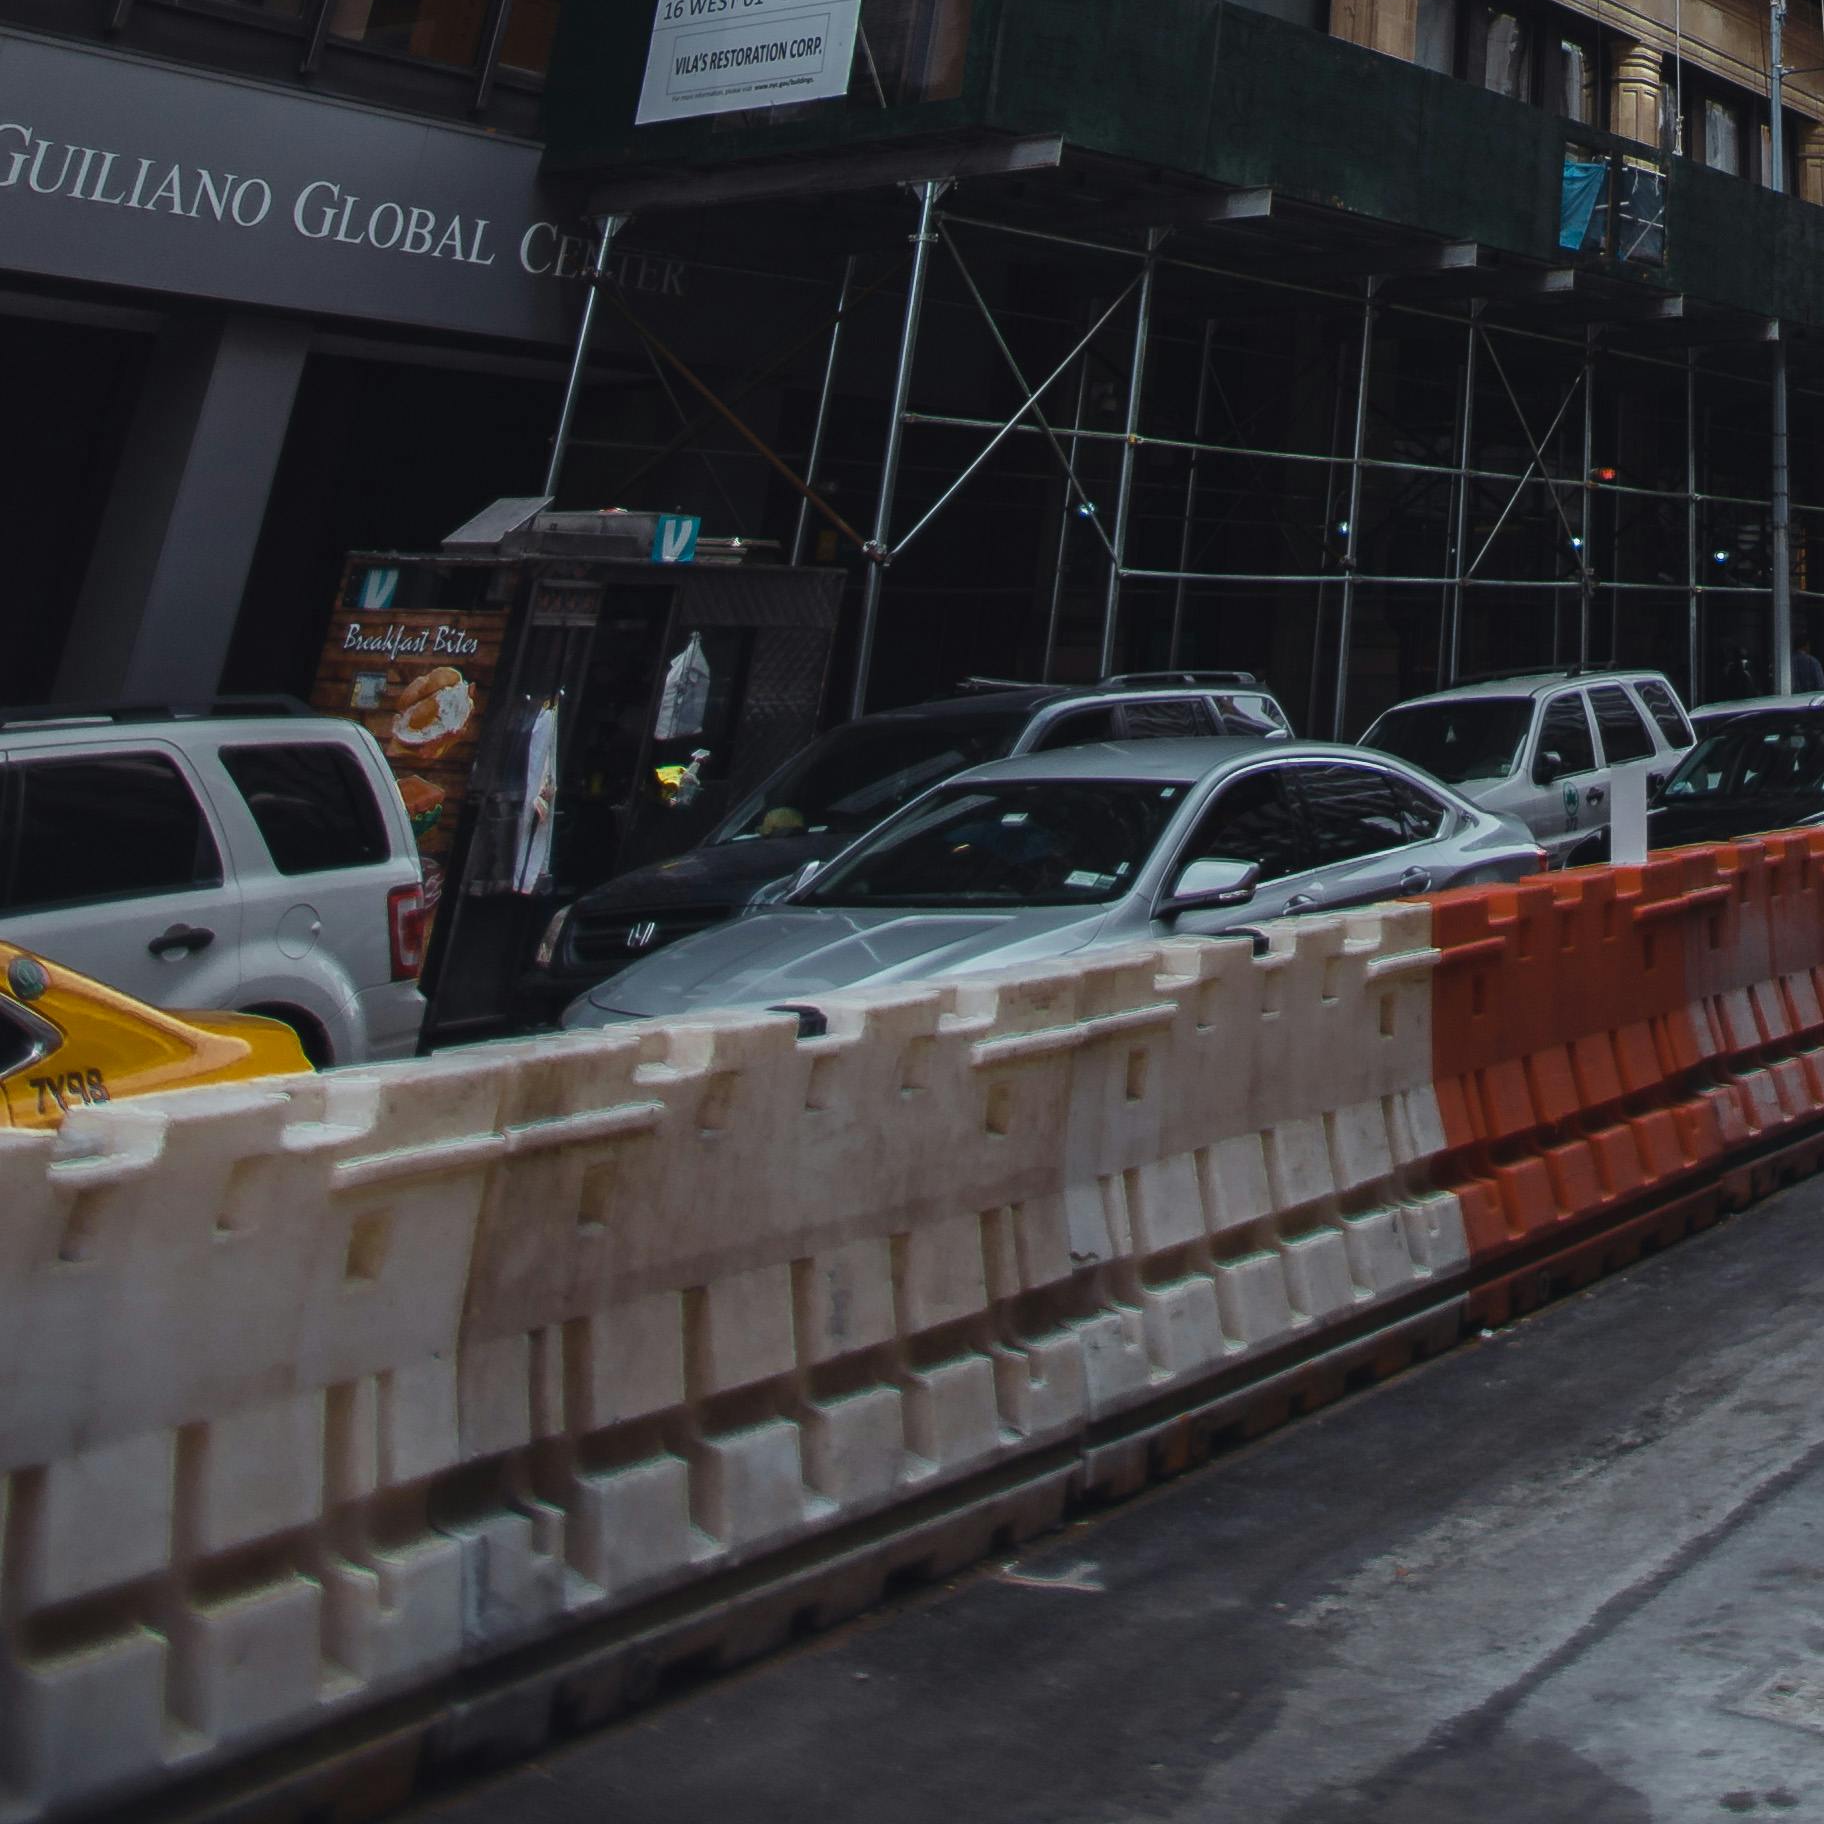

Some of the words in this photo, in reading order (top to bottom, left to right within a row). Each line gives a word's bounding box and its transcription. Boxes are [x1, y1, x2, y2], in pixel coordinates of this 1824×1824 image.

[663, 0, 684, 21] 16
[674, 52, 709, 75] VILA'S
[709, 41, 789, 69] RESTORATION
[789, 36, 823, 58] CORP.
[293, 180, 497, 266] GLOBAL
[343, 622, 430, 661] Breakfast
[432, 624, 479, 653] Bites
